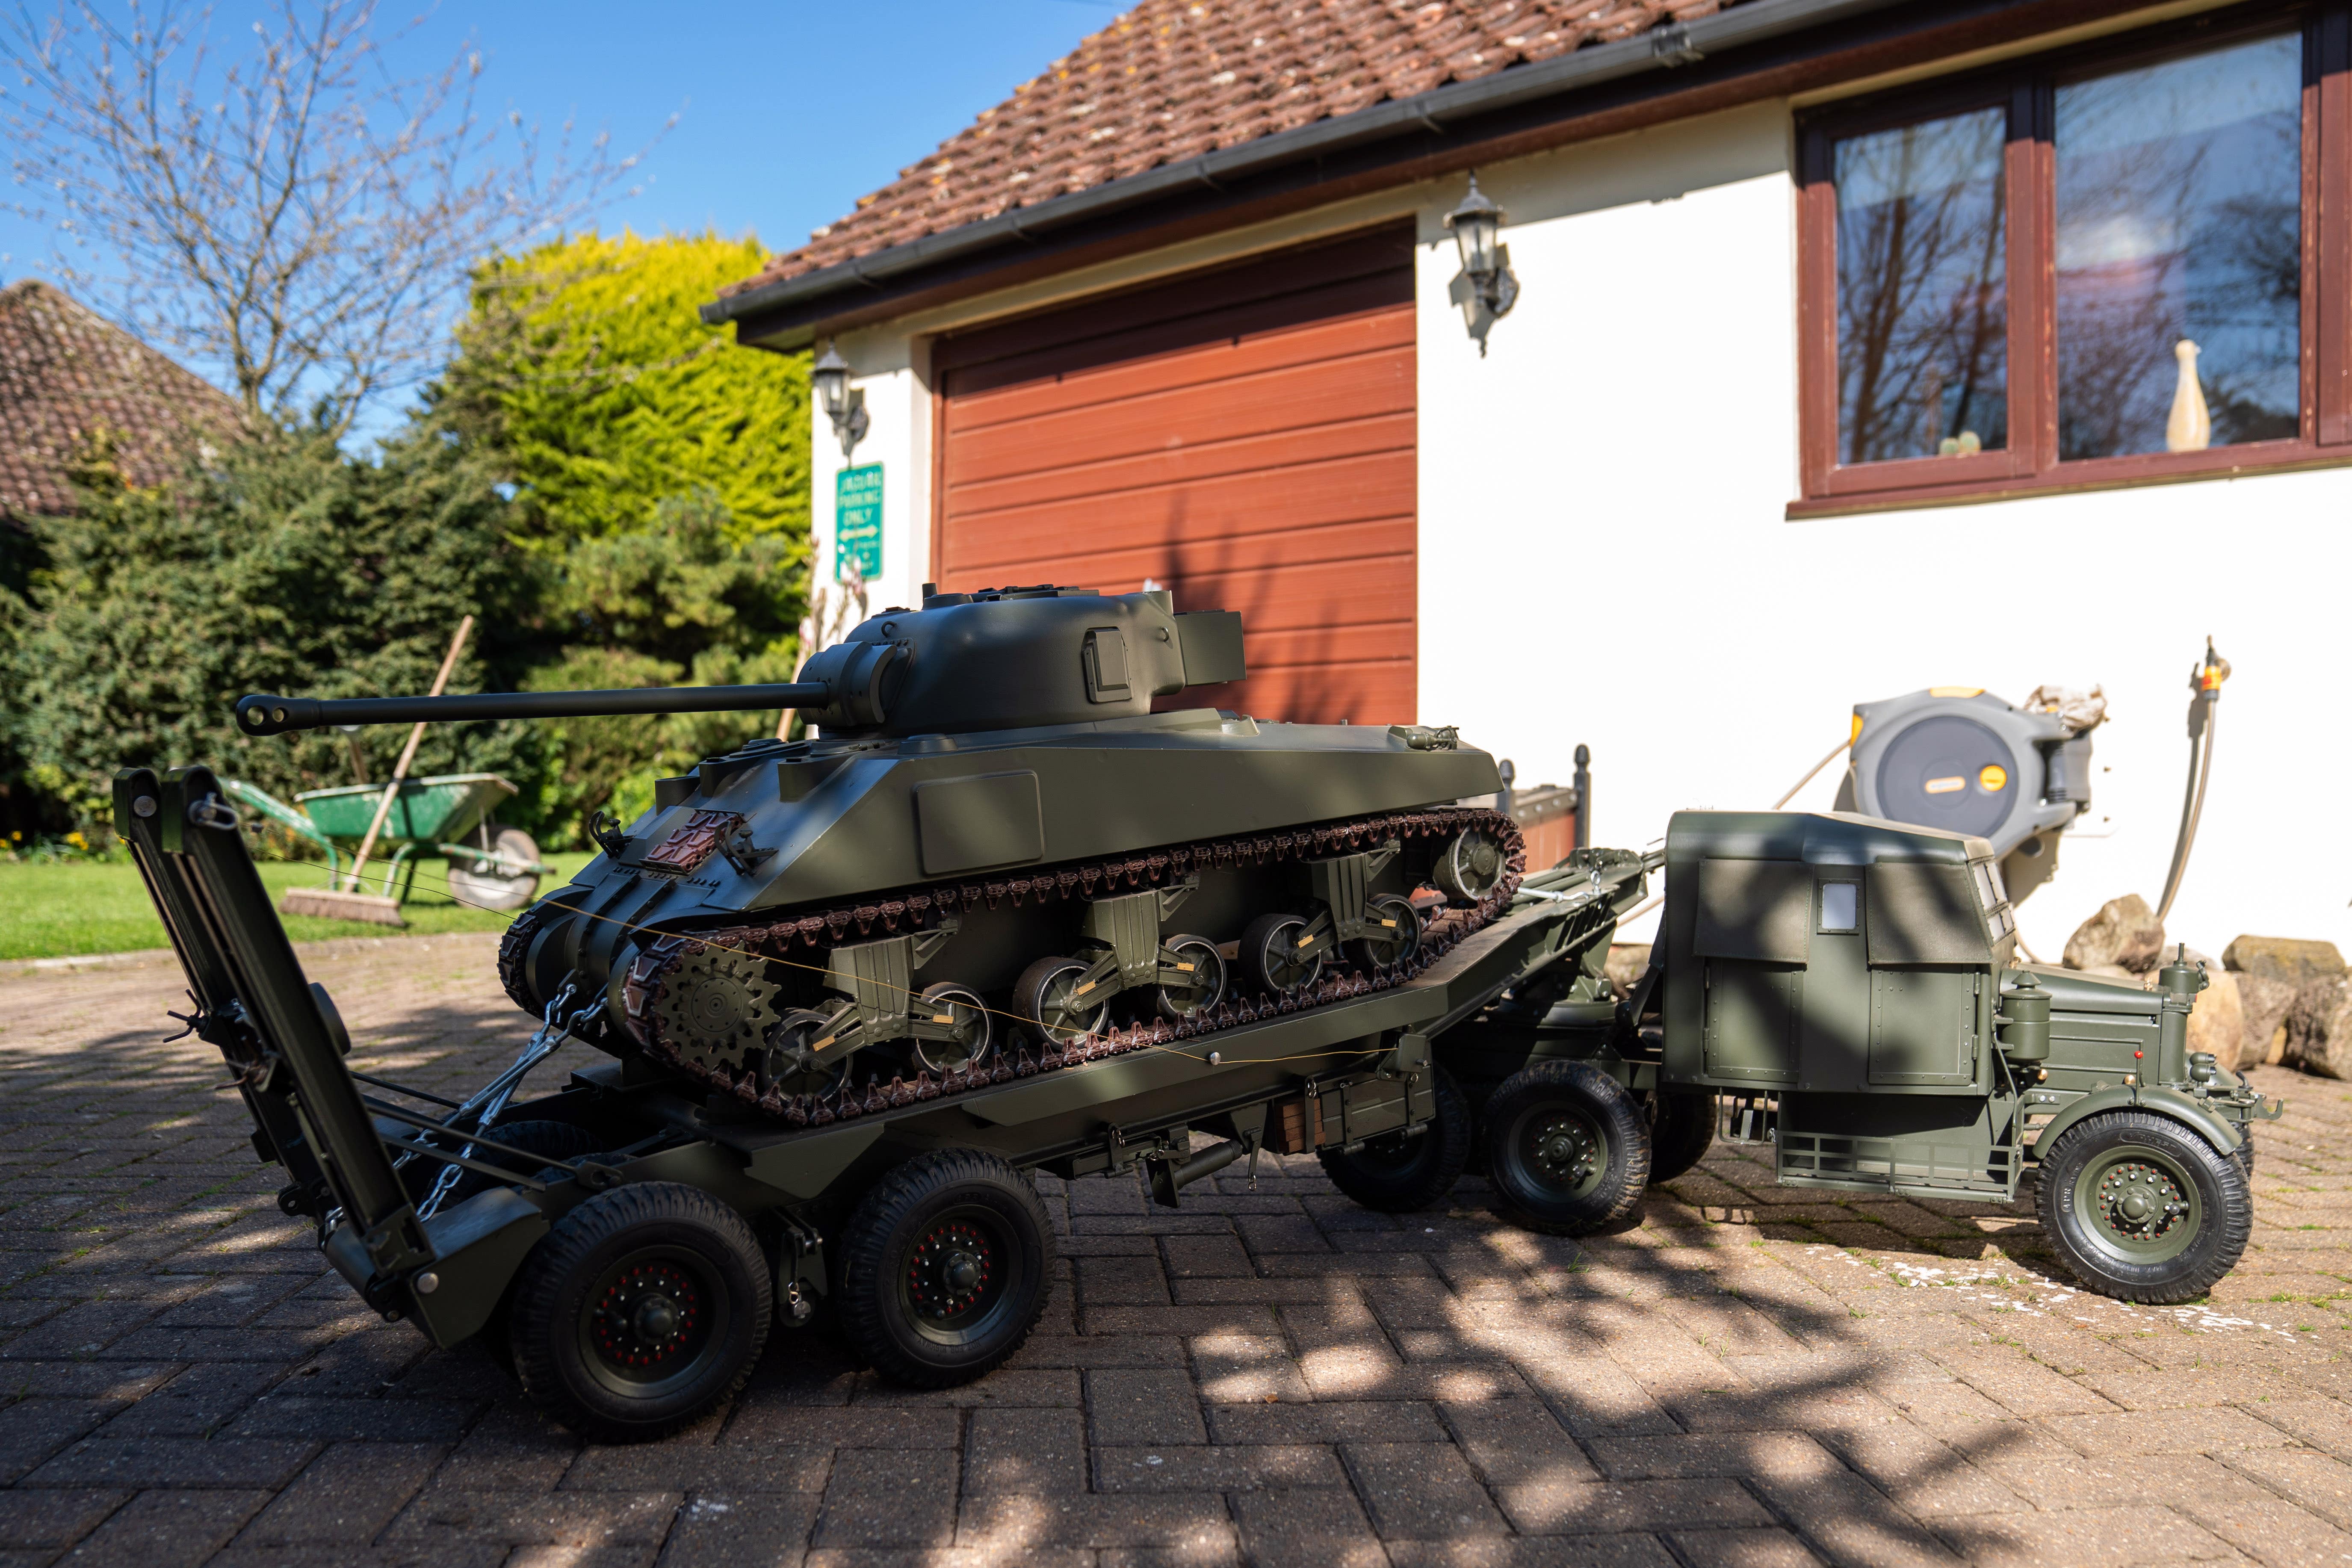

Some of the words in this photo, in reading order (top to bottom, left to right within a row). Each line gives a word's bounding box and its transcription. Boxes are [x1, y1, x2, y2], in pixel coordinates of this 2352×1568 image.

[843, 508, 873, 526] ONLY
[917, 1337, 947, 1353] HIGHWAY
[951, 1346, 964, 1354] FOR
